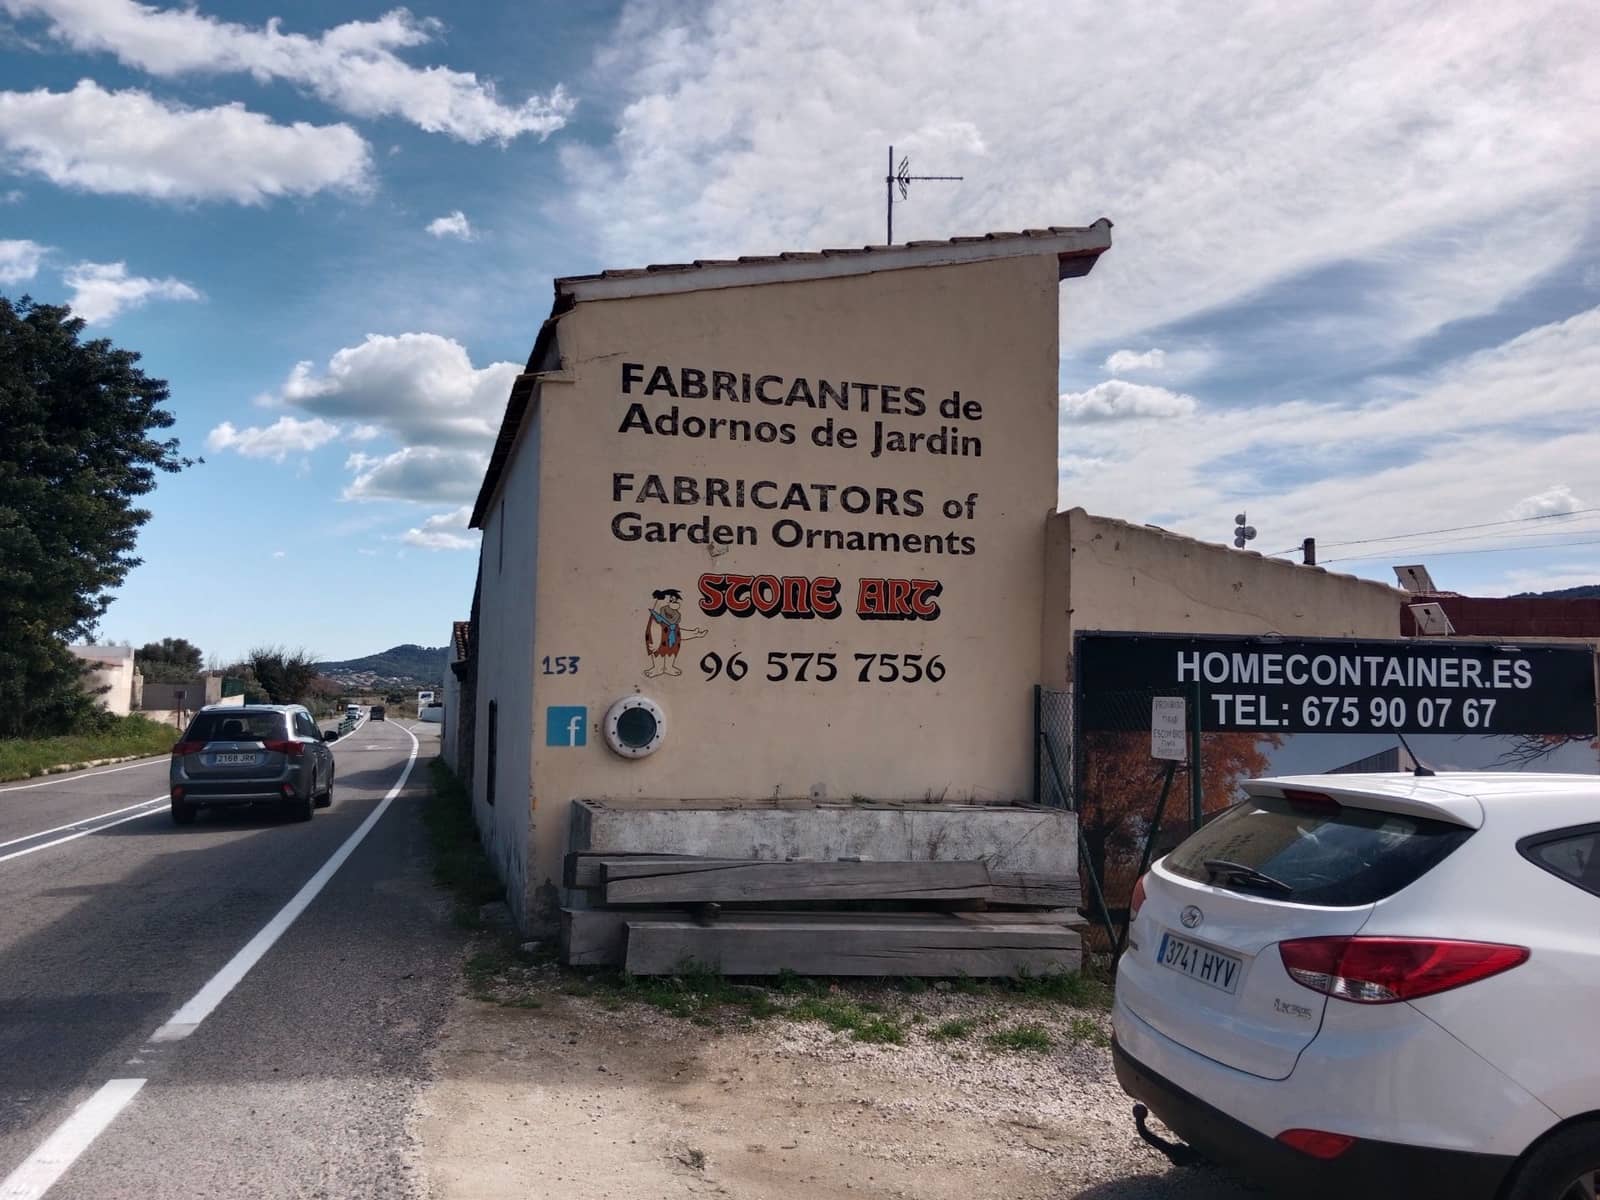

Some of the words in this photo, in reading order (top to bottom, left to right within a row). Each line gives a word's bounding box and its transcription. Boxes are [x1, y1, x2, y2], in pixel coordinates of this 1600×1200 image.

[621, 362, 927, 417] FABRICANTES
[939, 391, 983, 420] de
[618, 402, 797, 445] Adornos
[811, 418, 858, 449] de
[870, 421, 982, 458] Jardin
[612, 472, 925, 517] FABRICATORS
[942, 493, 978, 520] of
[611, 511, 757, 546] Garden
[772, 519, 976, 555] Ornaments
[698, 573, 842, 619] STONE
[856, 577, 943, 621] ART
[542, 656, 580, 675] 153
[700, 651, 748, 681] 96
[766, 652, 837, 682] 575
[854, 652, 946, 683] 7556
[1177, 651, 1532, 689] HOMECONTAINER.ES
[1211, 694, 1289, 726] TEL:
[1302, 696, 1360, 727] 675
[1370, 697, 1406, 728] 90
[1417, 697, 1452, 728] 07
[1462, 698, 1497, 728] 67
[1166, 940, 1199, 974] 3741
[1200, 955, 1236, 988] HYV
